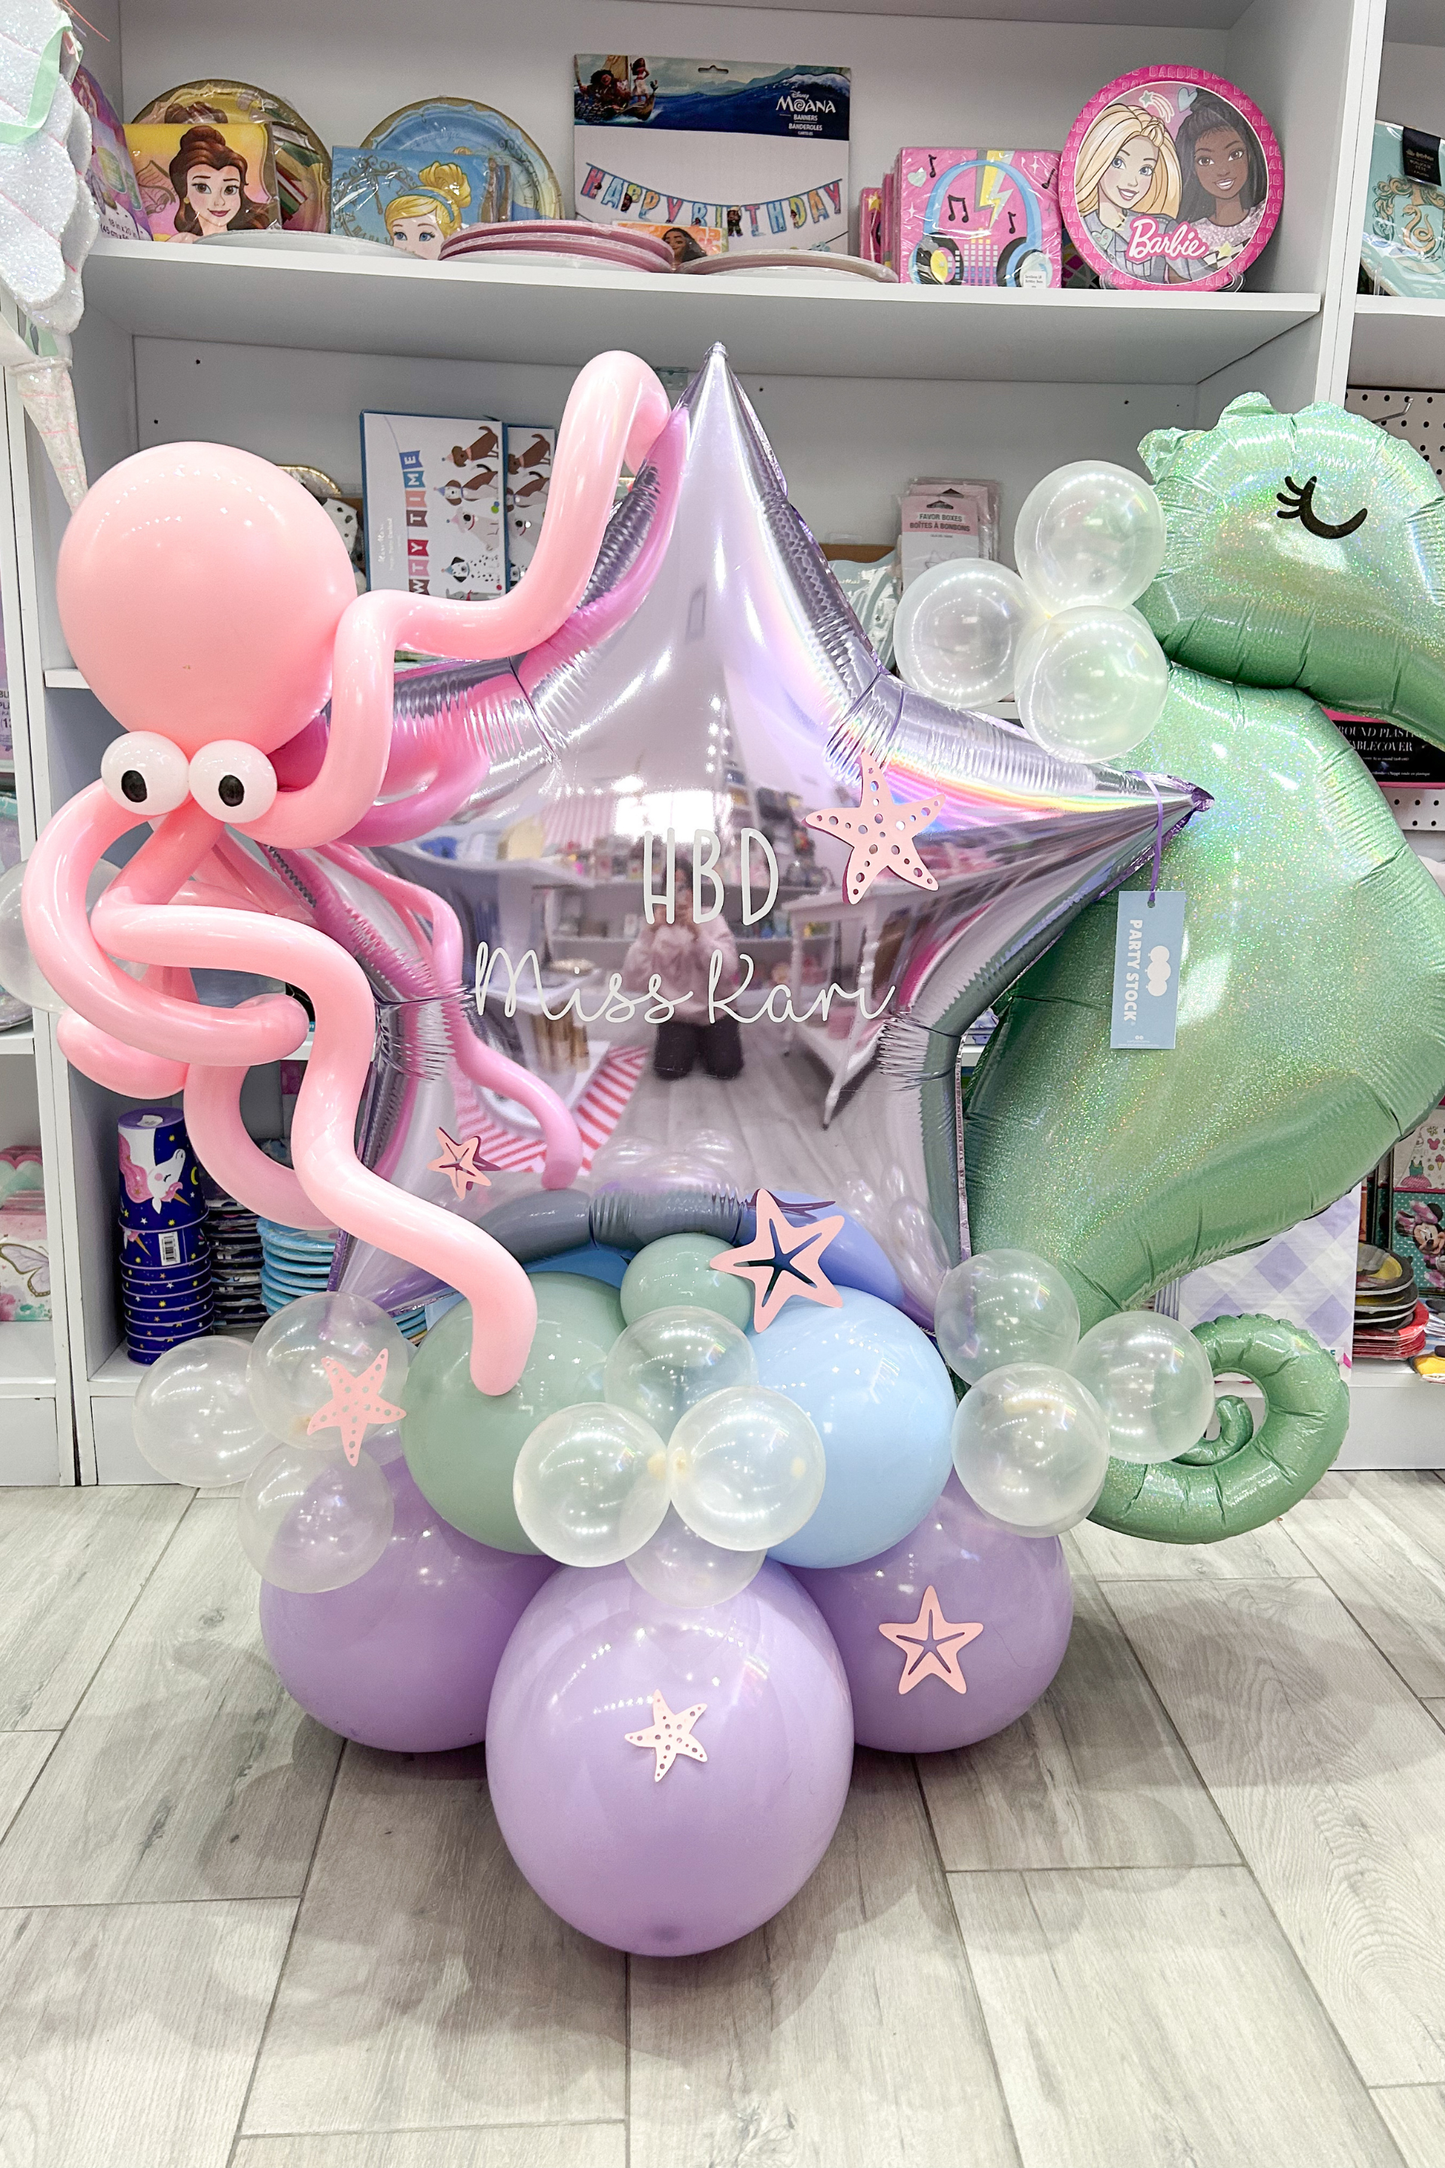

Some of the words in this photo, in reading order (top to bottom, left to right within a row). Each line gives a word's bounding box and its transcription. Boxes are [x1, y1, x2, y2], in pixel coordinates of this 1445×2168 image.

[775, 95, 837, 114] MOANA
[788, 123, 823, 131] BANDEROLES
[580, 167, 683, 224] HAPPY
[690, 180, 841, 237] BIRTHDAY
[1128, 217, 1206, 258] Barbie
[403, 454, 424, 524] TIME
[909, 520, 933, 529] BOÎTES
[933, 521, 939, 529] À
[939, 524, 971, 532] BONBONS
[941, 514, 963, 522] BOXES
[1349, 740, 1413, 752] ABLECOVER
[644, 827, 779, 926] HBD
[1127, 919, 1143, 970] PARTY
[474, 941, 695, 1024] Miss
[707, 948, 897, 1025] Kari
[1123, 972, 1139, 1022] STOCK
